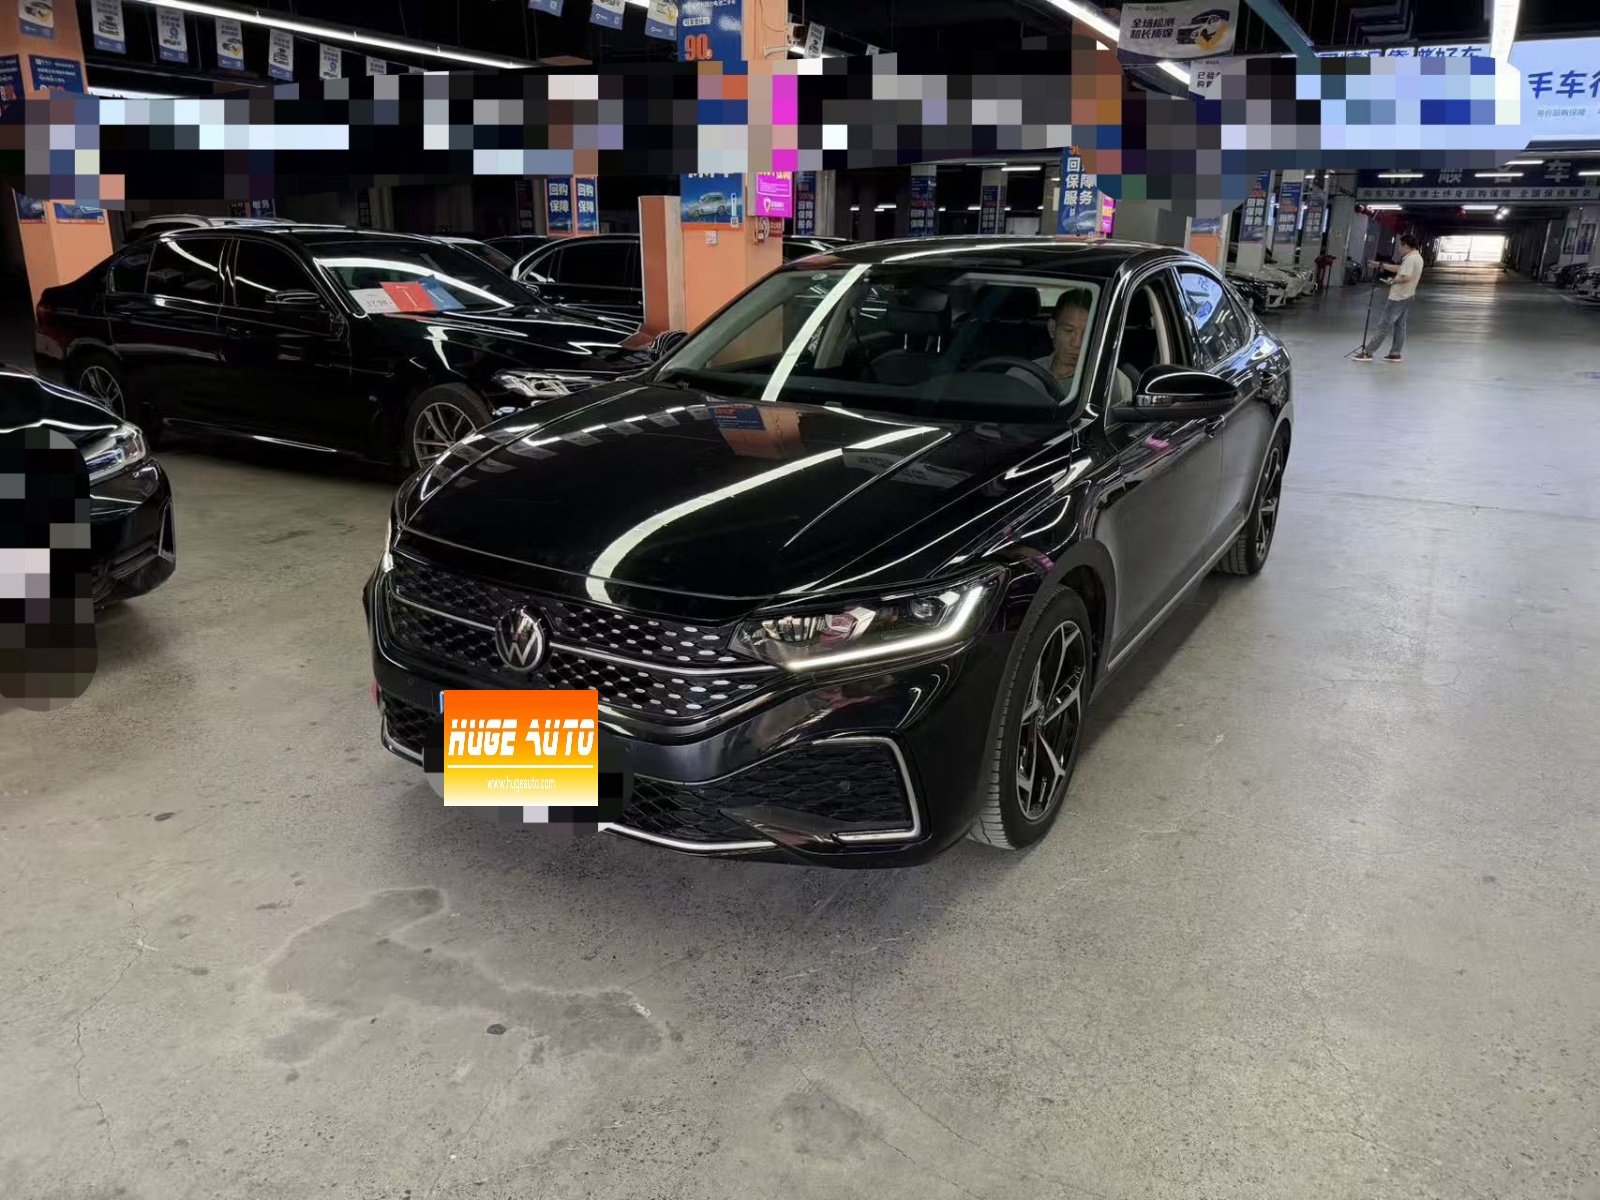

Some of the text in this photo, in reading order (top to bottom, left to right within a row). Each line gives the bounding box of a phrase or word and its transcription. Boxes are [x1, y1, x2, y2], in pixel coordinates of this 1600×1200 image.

[1131, 18, 1176, 28] 全场检测
[1130, 29, 1173, 39] 超长质保
[549, 183, 568, 196] 回购
[578, 184, 594, 197] 回购
[1064, 190, 1092, 205] 服务
[550, 200, 569, 213] 保障
[578, 201, 594, 214] 保障
